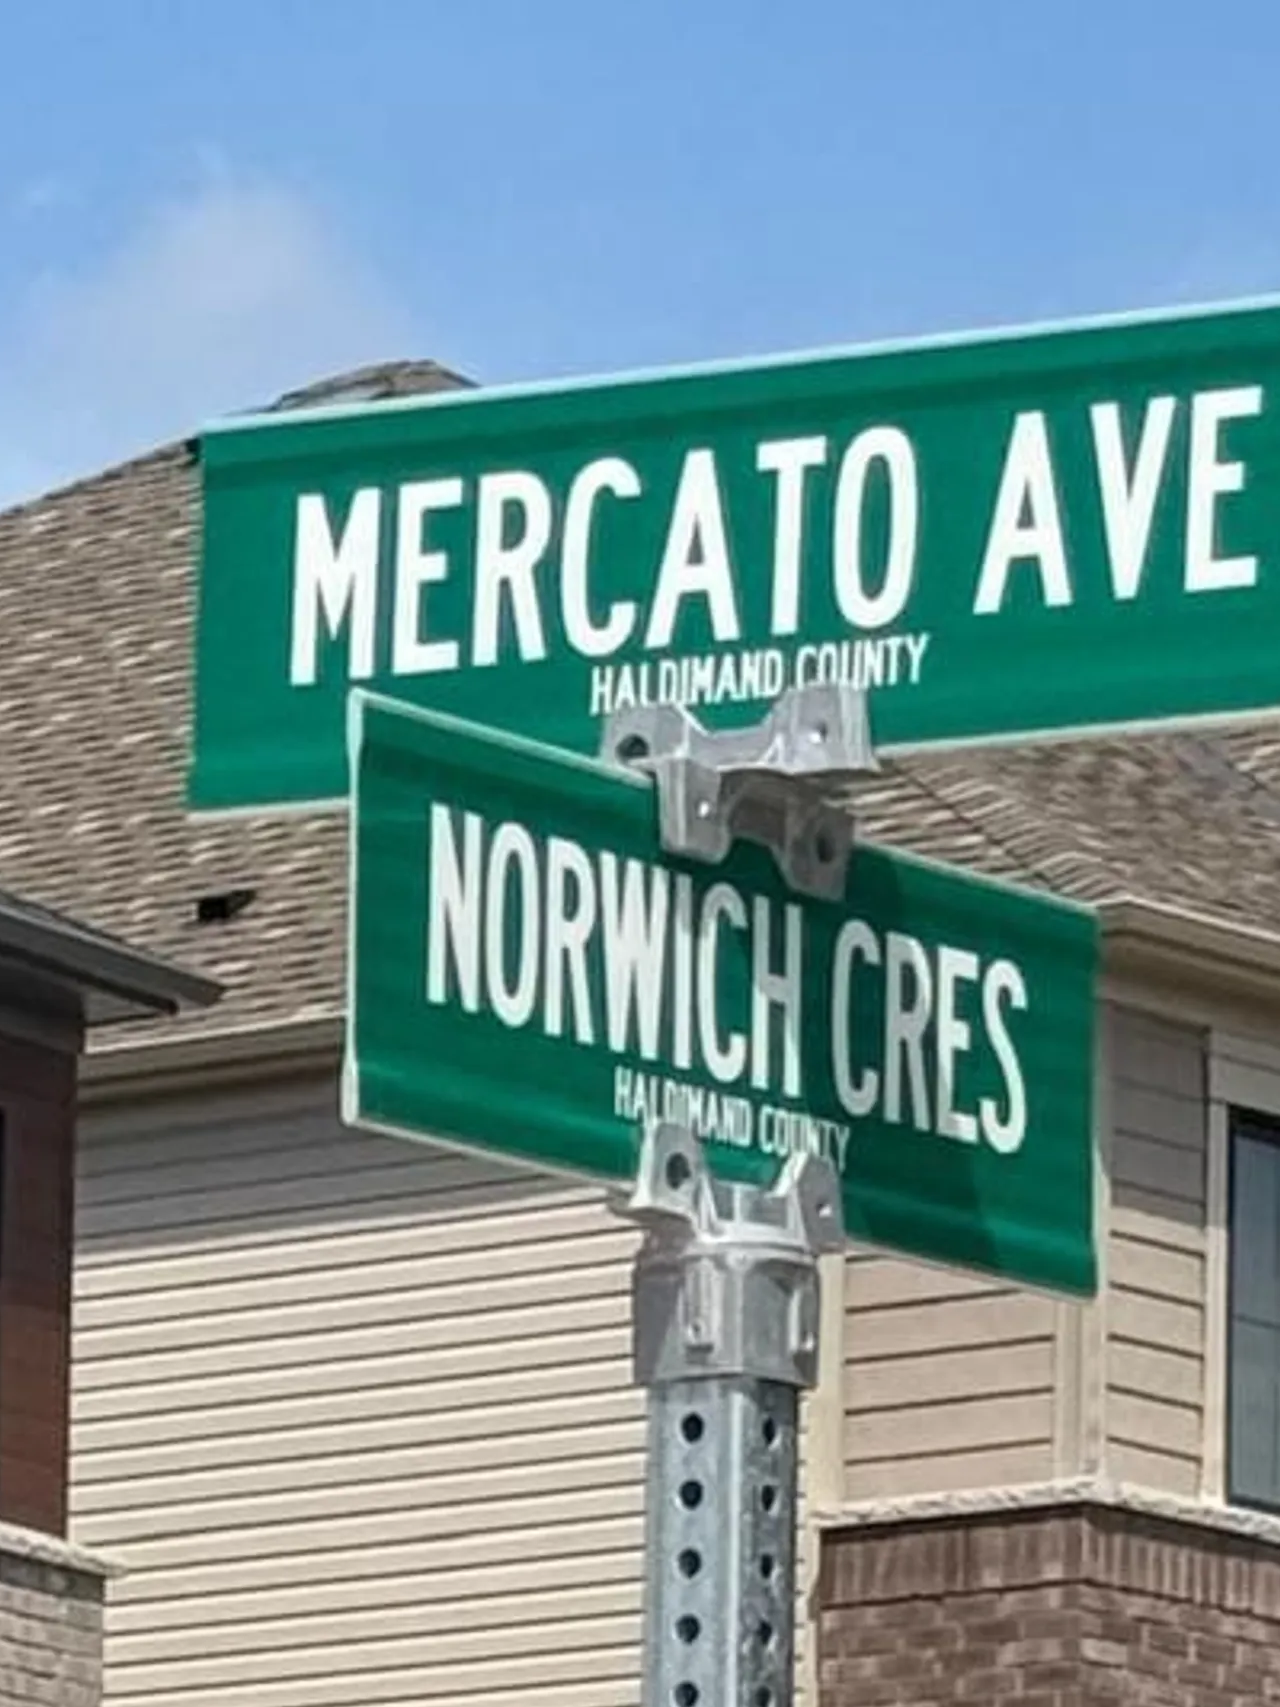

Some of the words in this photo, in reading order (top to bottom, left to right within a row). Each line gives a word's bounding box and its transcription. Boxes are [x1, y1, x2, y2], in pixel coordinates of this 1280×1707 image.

[290, 426, 918, 685] MERCATO
[972, 386, 1263, 614] AVE
[589, 649, 784, 716] HALDIMAND
[796, 632, 930, 690] COUNTY
[426, 801, 801, 1099] NORWICH
[832, 920, 1028, 1155] CRES
[614, 1066, 752, 1147] HALDIMAND
[759, 1105, 851, 1173] COUNTY
